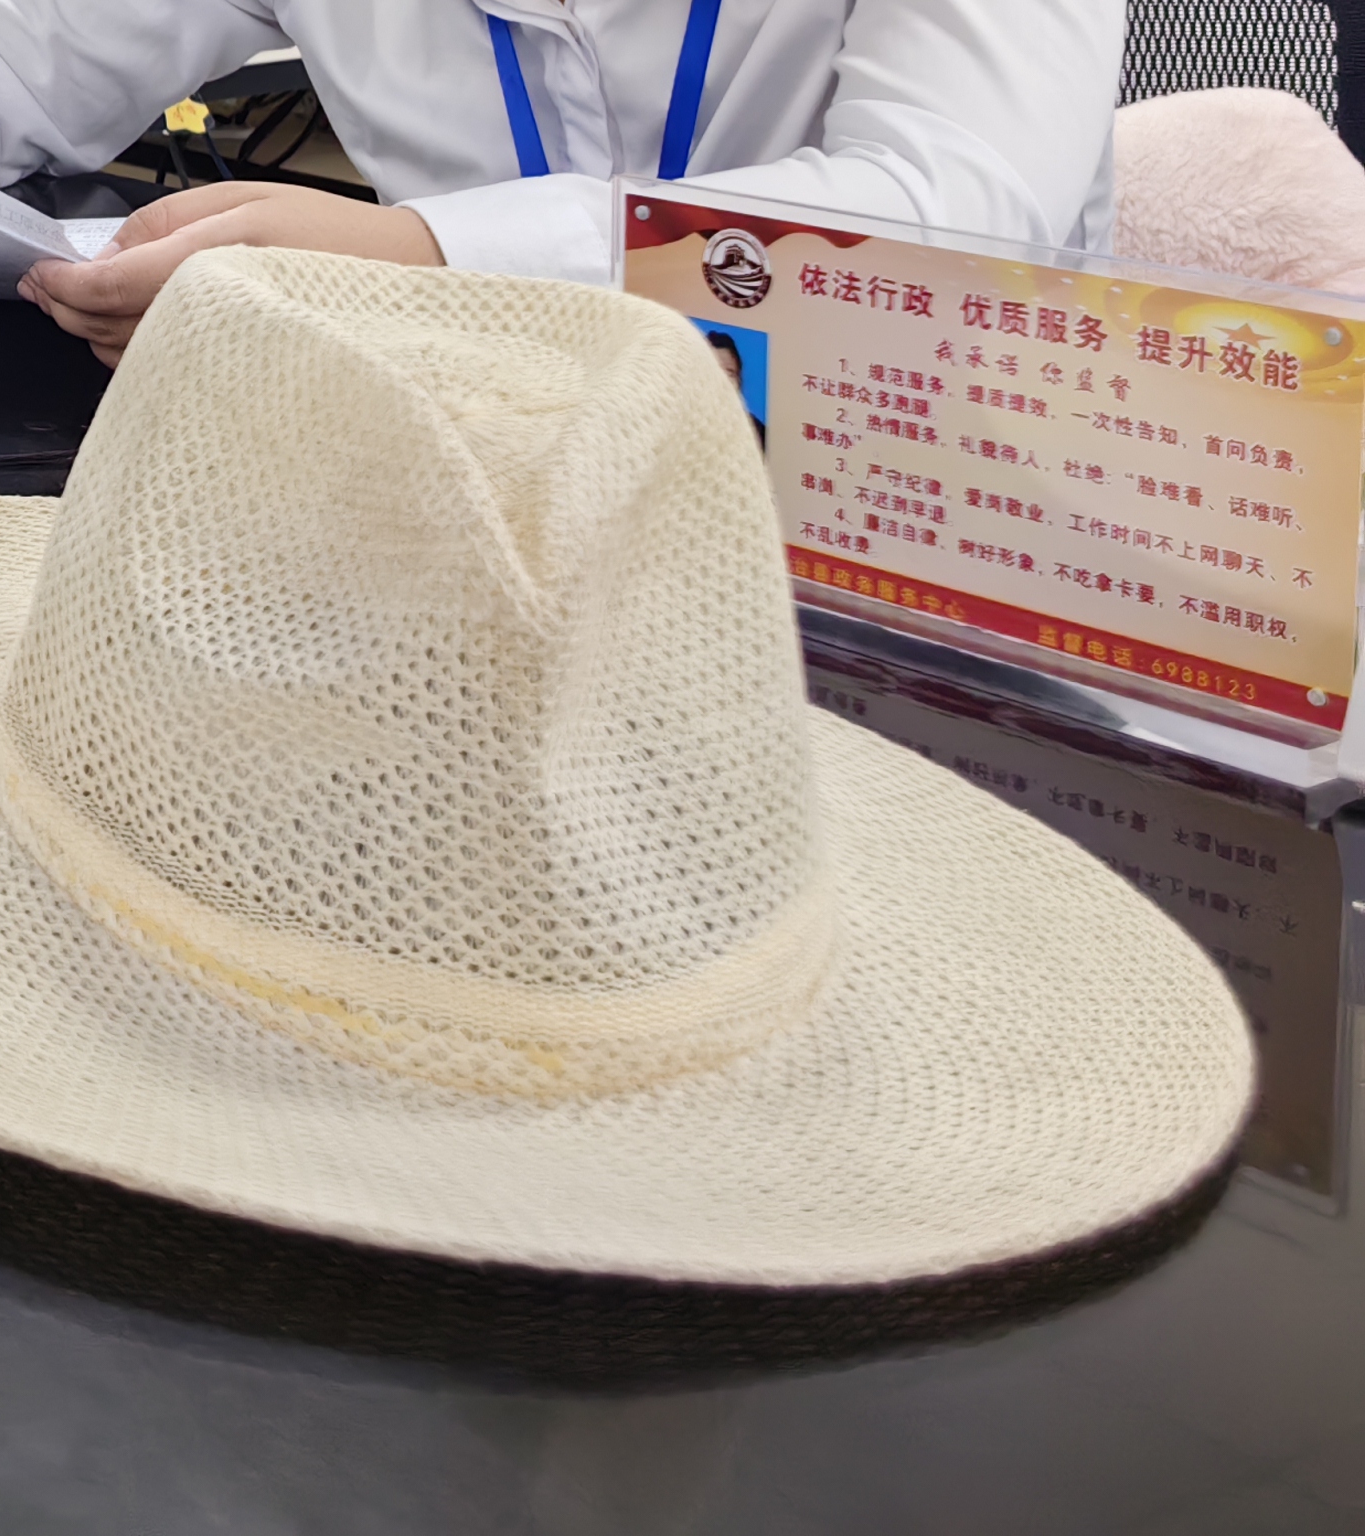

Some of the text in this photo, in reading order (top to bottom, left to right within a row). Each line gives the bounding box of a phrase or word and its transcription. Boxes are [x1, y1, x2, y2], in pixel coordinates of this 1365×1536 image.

[798, 262, 934, 319] 依法行政
[959, 292, 1109, 353] 优质服务
[1136, 324, 1300, 391] 提升效能
